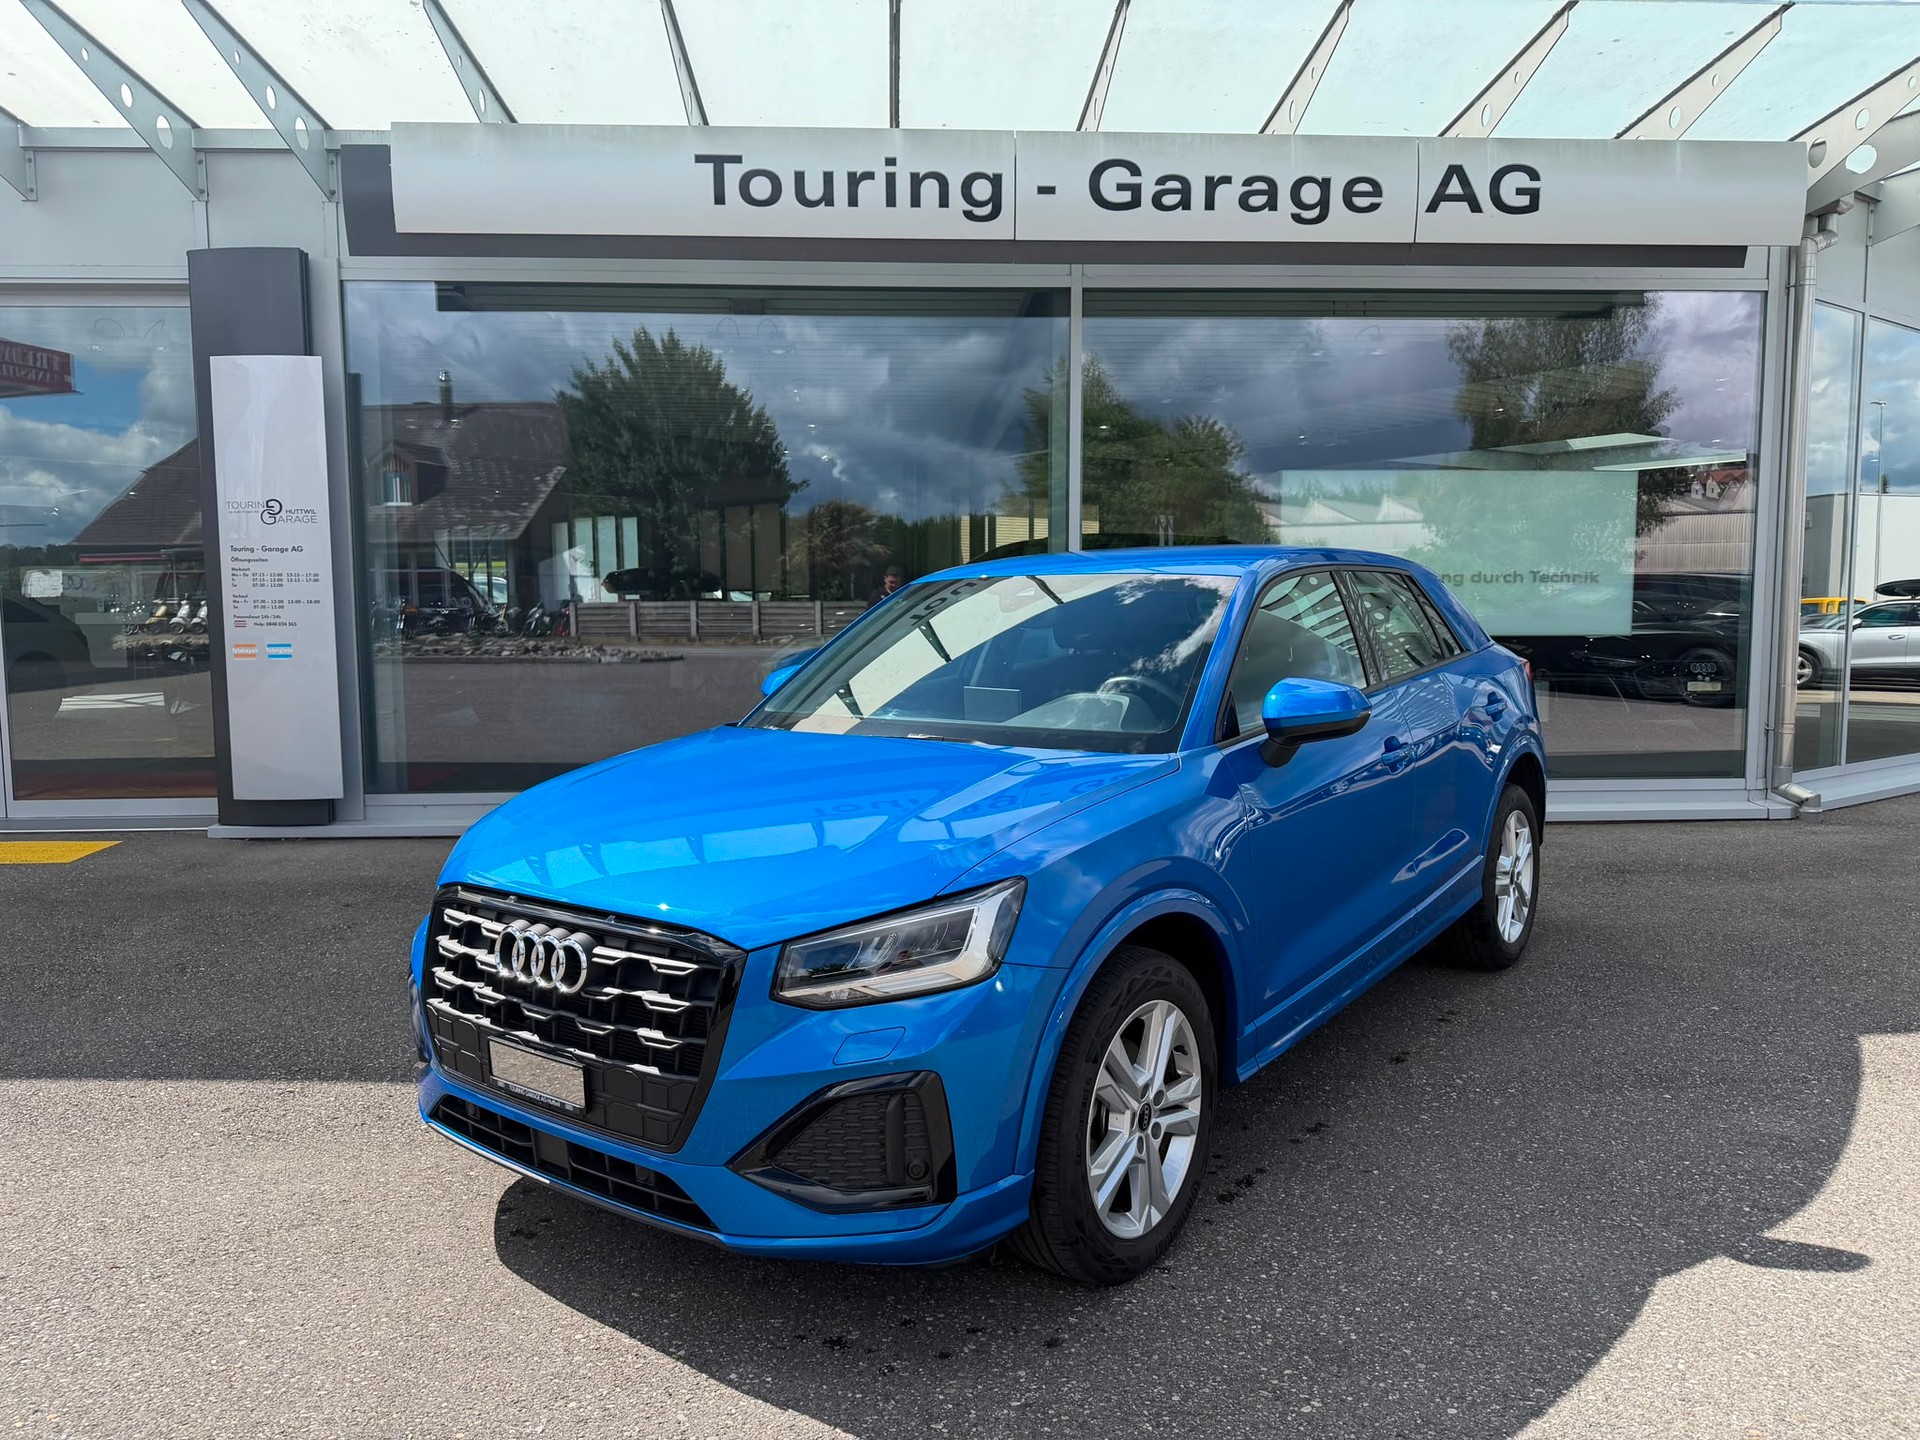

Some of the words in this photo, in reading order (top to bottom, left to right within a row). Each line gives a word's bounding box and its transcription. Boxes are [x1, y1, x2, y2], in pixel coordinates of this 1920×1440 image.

[694, 154, 1003, 222] Touring
[1037, 185, 1056, 195] -
[1089, 158, 1383, 225] Garage
[1425, 164, 1541, 215] AG
[230, 545, 255, 554] Touring
[261, 545, 289, 554] Garage
[1470, 570, 1524, 584] durch
[1529, 570, 1600, 584] Technik
